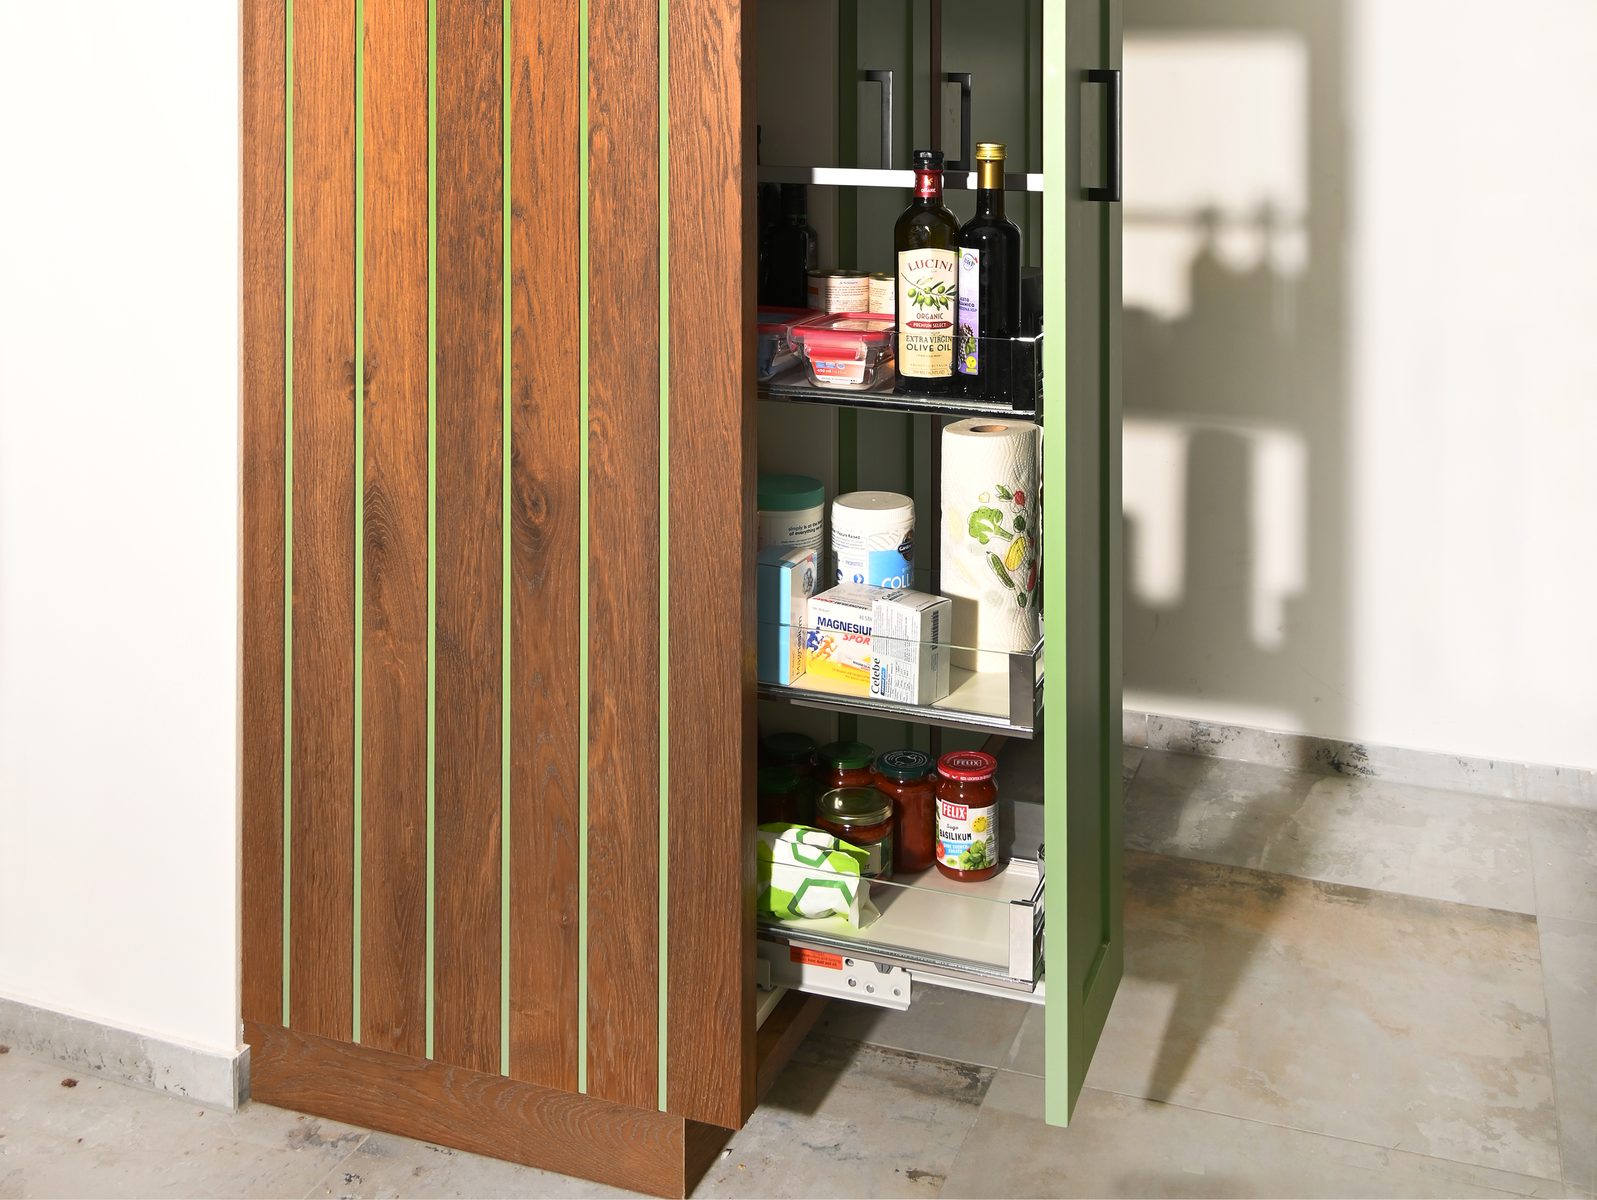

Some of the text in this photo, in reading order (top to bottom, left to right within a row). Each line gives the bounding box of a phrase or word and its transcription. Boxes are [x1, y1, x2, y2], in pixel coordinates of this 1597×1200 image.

[907, 259, 953, 272] LUCINI
[916, 312, 944, 320] ORGANIC
[905, 334, 953, 344] EXTRA VIRGIN
[906, 343, 952, 353] OLIVE OIL
[881, 573, 911, 589] COLL
[842, 632, 871, 646] SPOR
[943, 801, 966, 819] FELIX
[940, 829, 972, 841] BASILIKUM
